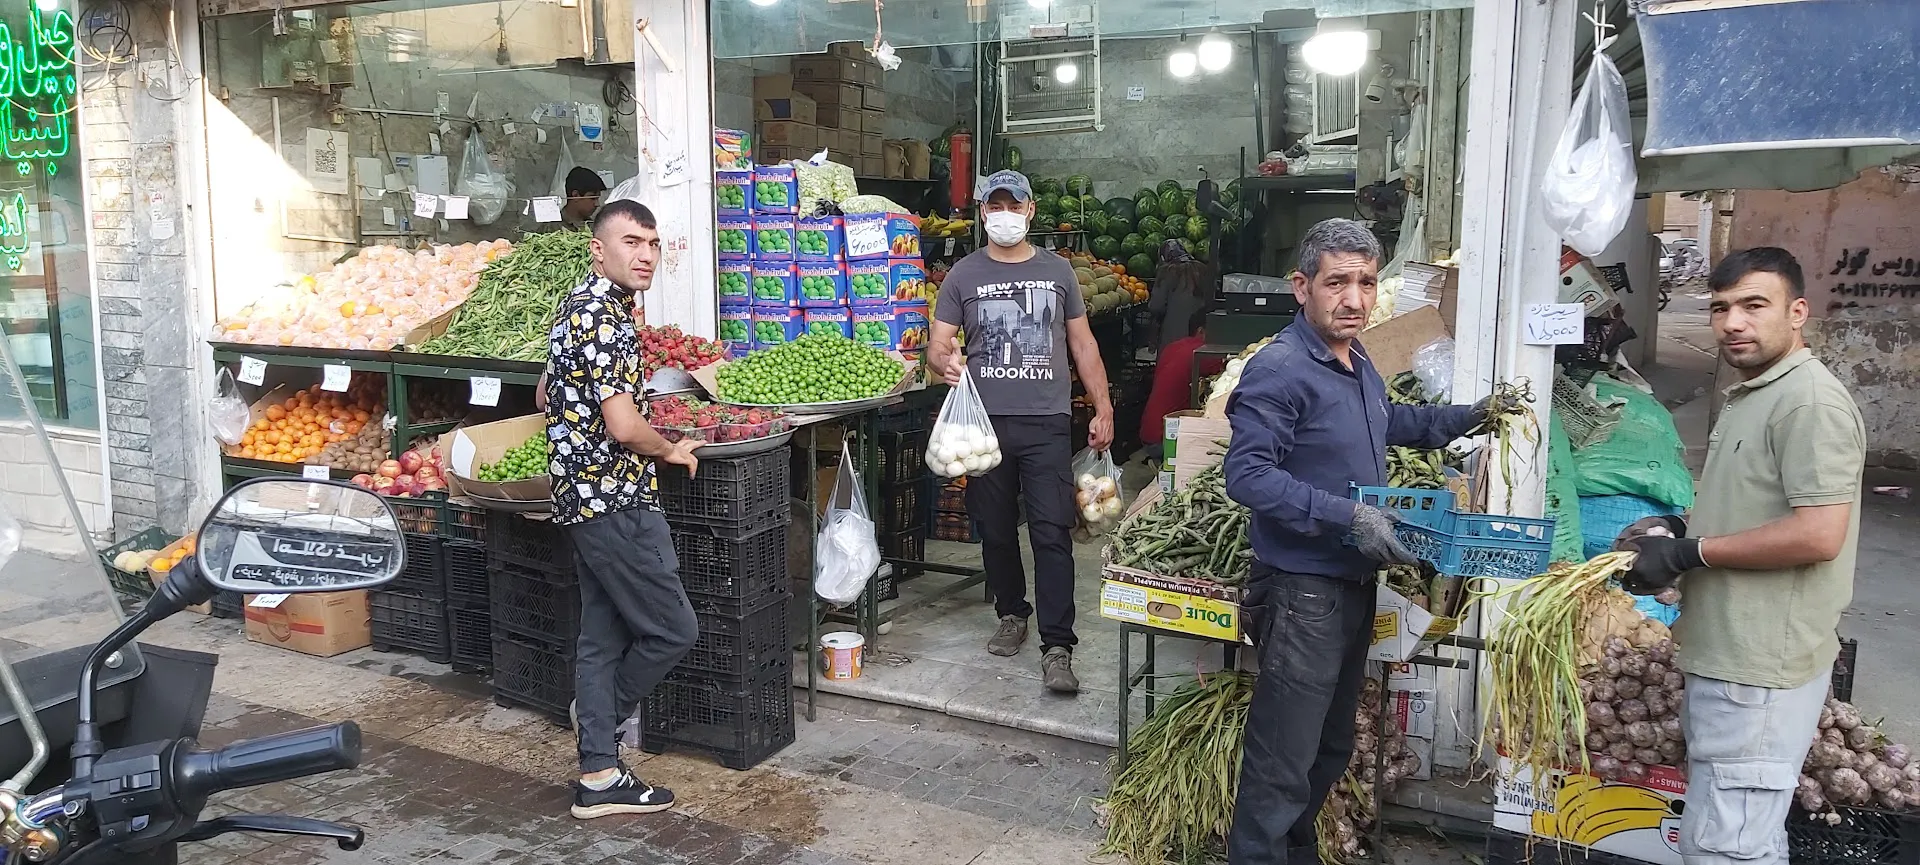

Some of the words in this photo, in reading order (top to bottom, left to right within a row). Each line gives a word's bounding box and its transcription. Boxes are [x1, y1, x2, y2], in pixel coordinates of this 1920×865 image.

[0, 94, 69, 176] لبنیا
[977, 283, 1012, 295] NEW
[1014, 281, 1056, 290] YORK
[980, 366, 1053, 380] BROOKLYN
[577, 470, 600, 483] PLAY
[1133, 576, 1167, 588] PINEAPPLE
[1185, 607, 1232, 629] DOLIE
[1374, 617, 1392, 625] PINE
[1502, 791, 1555, 814] PREMIUM
